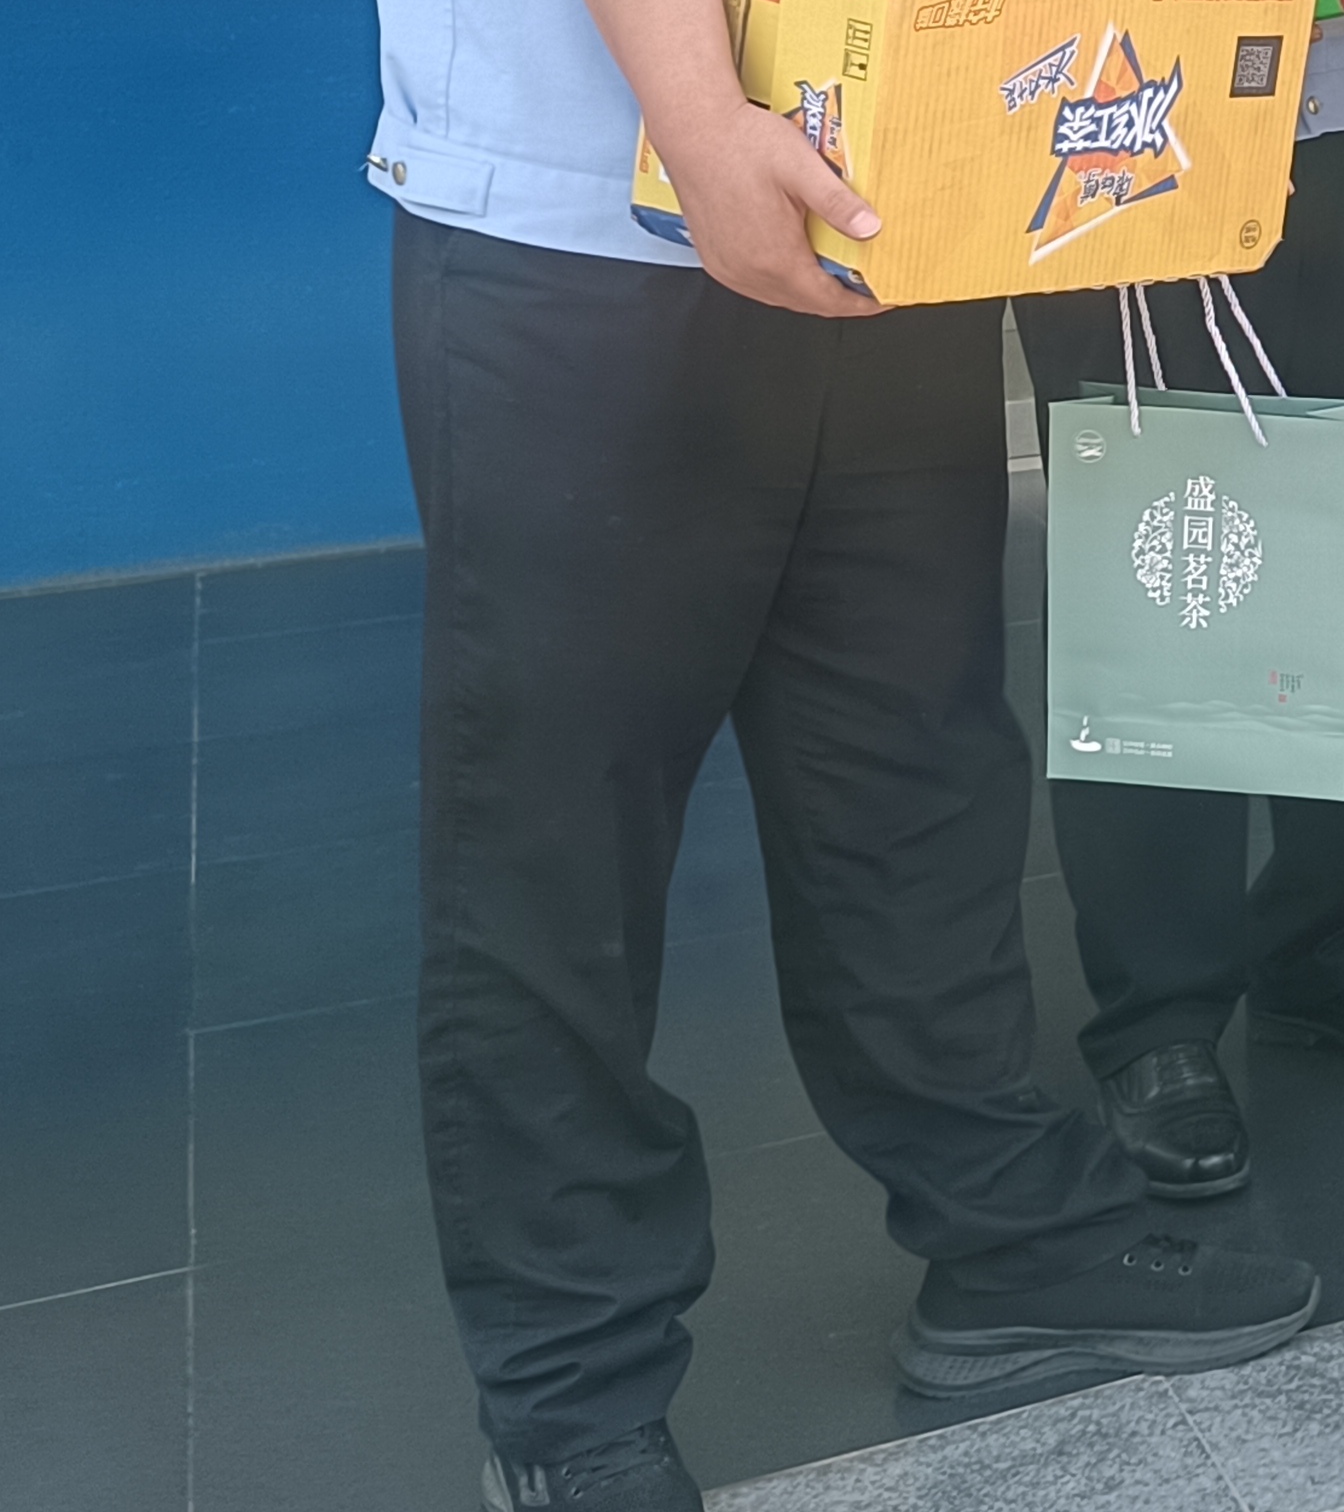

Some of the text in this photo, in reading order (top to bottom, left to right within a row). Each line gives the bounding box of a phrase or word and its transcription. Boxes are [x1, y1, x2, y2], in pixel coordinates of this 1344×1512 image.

[1054, 75, 1180, 154] 冰红茶
[1178, 475, 1217, 630] 盛园茗茶
